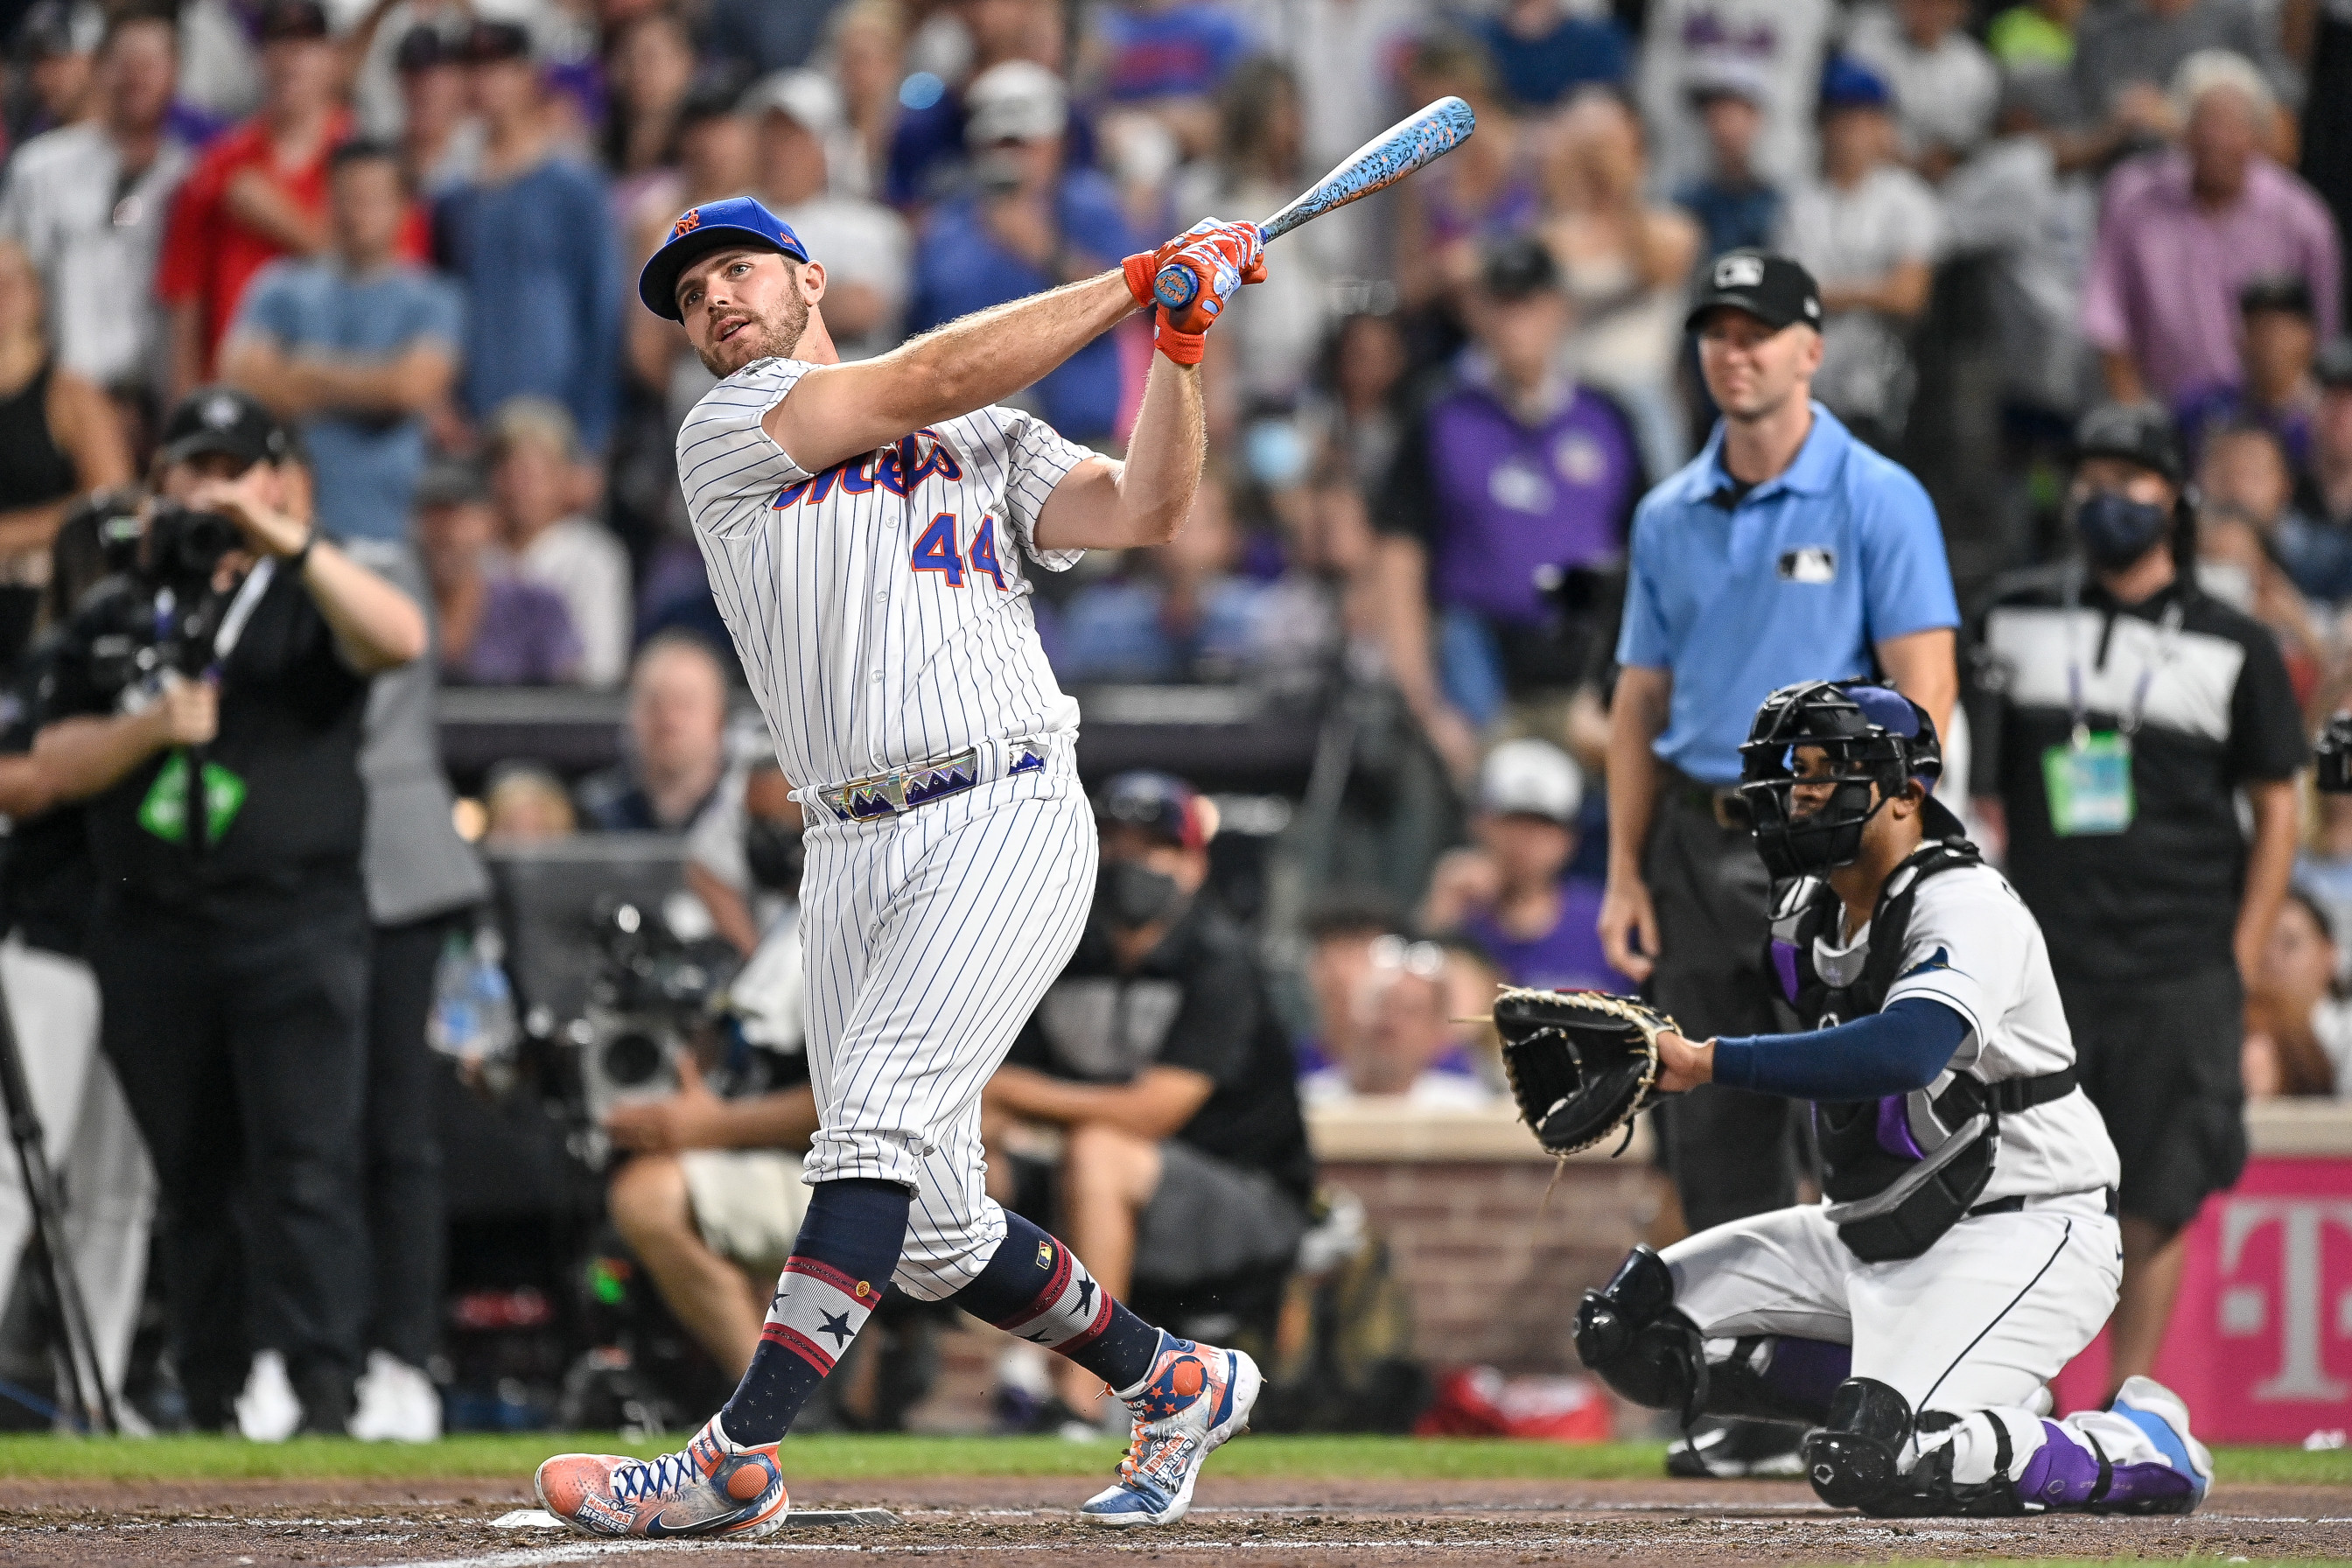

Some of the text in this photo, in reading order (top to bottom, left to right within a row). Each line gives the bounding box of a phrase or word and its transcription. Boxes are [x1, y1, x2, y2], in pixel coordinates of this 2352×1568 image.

[911, 512, 1009, 592] 44
[579, 1506, 627, 1533] HEROES
[587, 1496, 631, 1524] HOMERS
